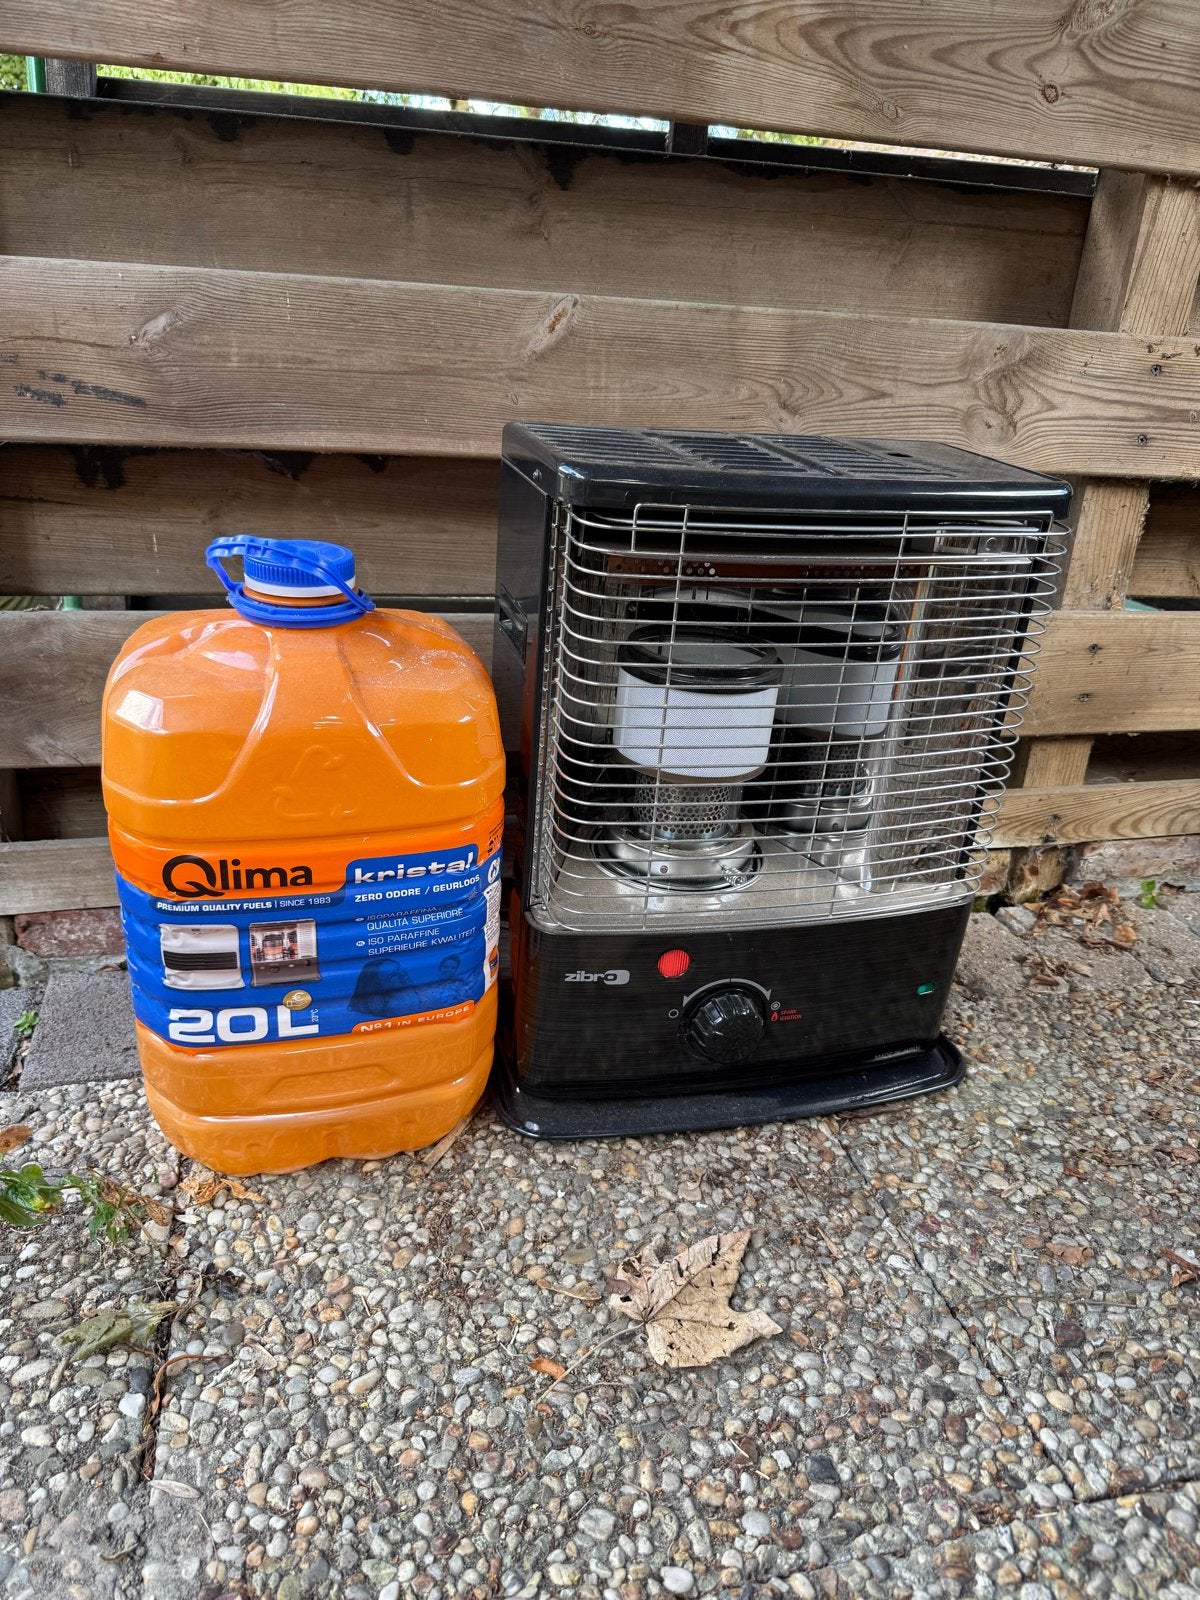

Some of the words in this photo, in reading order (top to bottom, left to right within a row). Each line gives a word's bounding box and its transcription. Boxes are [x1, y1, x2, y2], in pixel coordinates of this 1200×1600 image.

[162, 855, 313, 897] Qlima
[355, 852, 473, 883] kristal
[355, 892, 382, 902] ZERO
[386, 888, 420, 898] ODORE
[433, 875, 480, 893] GEURLOOS
[157, 901, 199, 912] PREMIUM
[202, 903, 240, 912] QUALITY
[243, 901, 272, 910] FUELS
[279, 899, 305, 908] SINCE
[308, 896, 331, 905] 1983
[411, 908, 463, 925] SUPERIORE
[368, 937, 384, 946] ISO
[387, 928, 440, 943] PARAFFINE
[368, 941, 428, 955] SUPERIEURE
[431, 927, 476, 946] KWALITEIT
[565, 970, 630, 985] zibro
[417, 1005, 470, 1022] EUROPE
